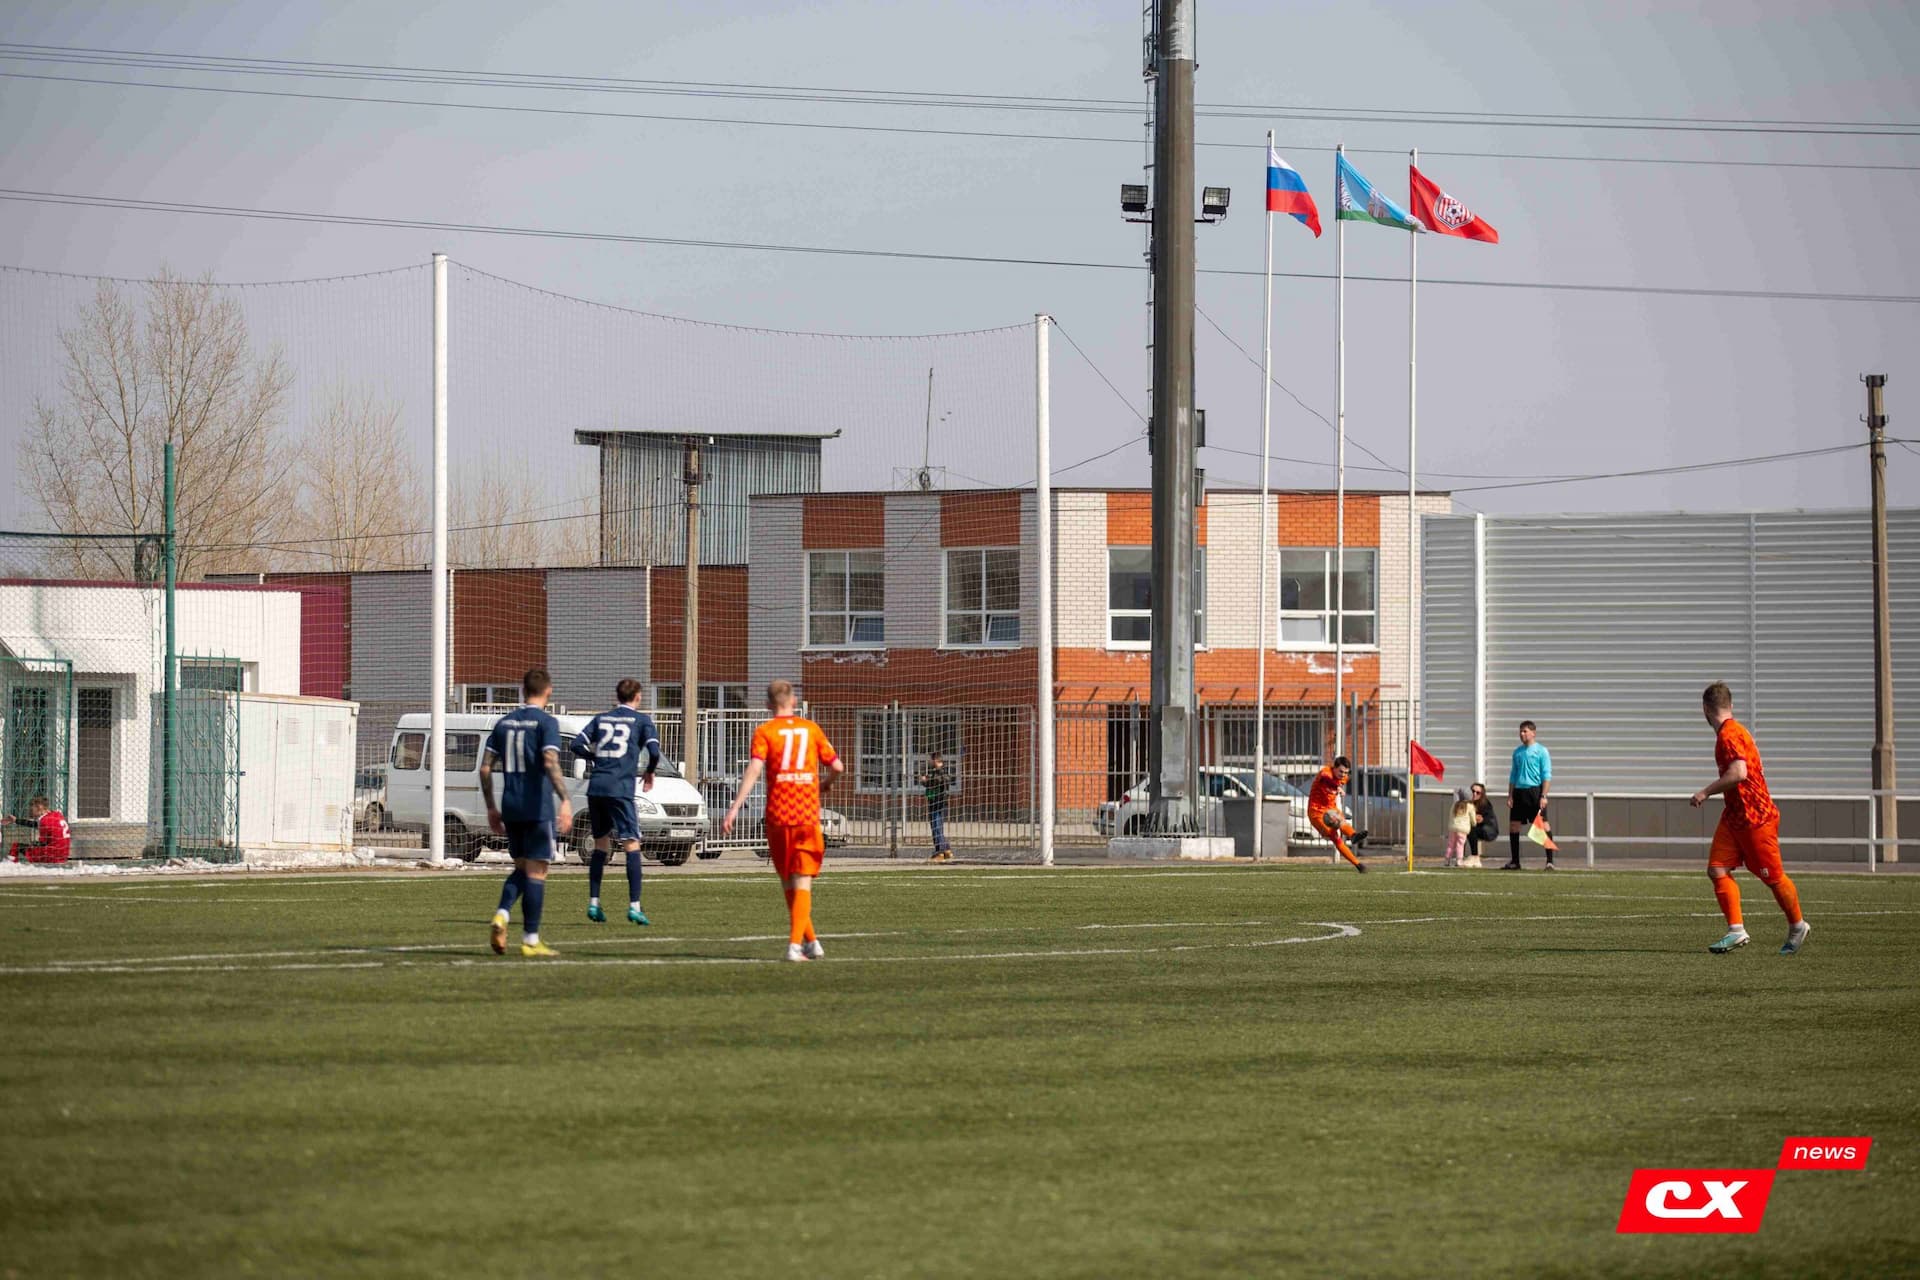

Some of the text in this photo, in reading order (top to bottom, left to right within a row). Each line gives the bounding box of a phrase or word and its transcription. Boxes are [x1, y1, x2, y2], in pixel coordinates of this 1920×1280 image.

[505, 729, 526, 773] 11
[595, 722, 631, 758] 23
[778, 727, 809, 770] 77
